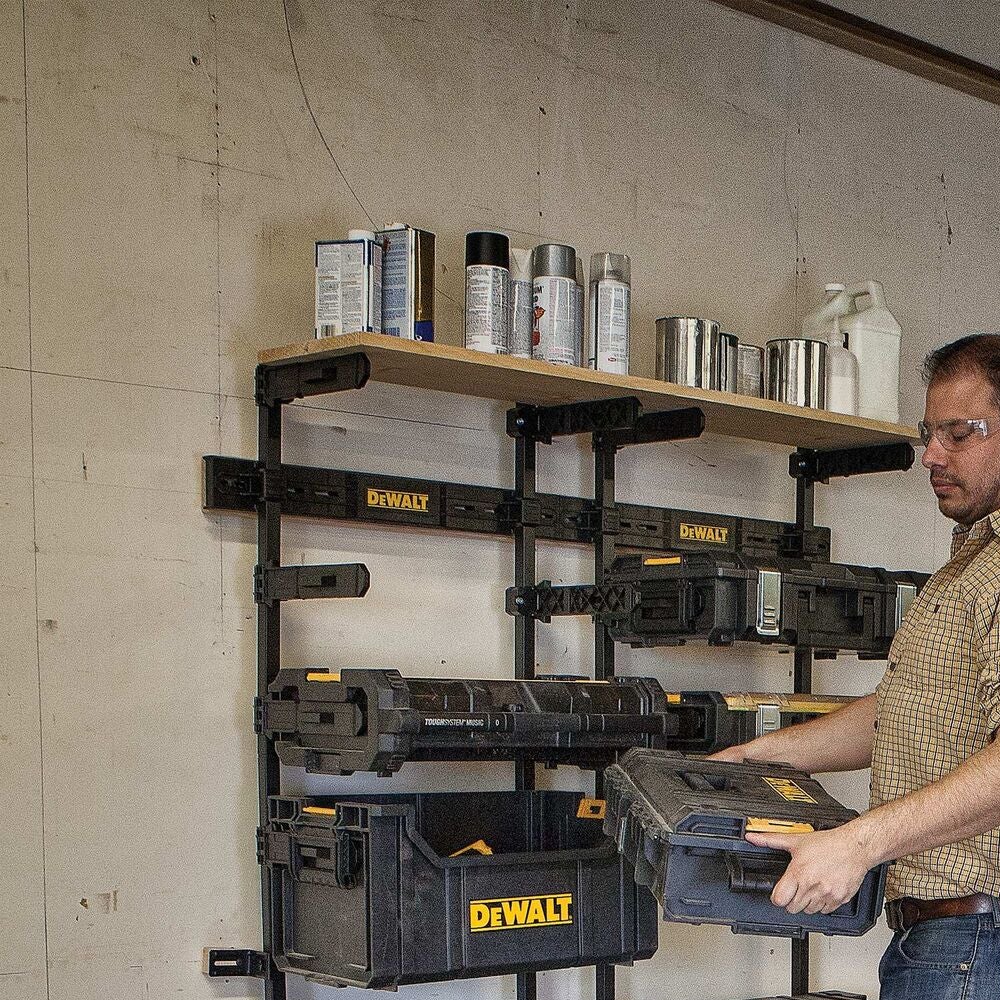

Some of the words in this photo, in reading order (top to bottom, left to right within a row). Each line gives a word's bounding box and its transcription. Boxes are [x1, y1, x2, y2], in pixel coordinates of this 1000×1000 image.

[368, 490, 428, 510] DEWALT
[680, 524, 728, 542] DEWALT
[470, 897, 572, 929] DEWALT
